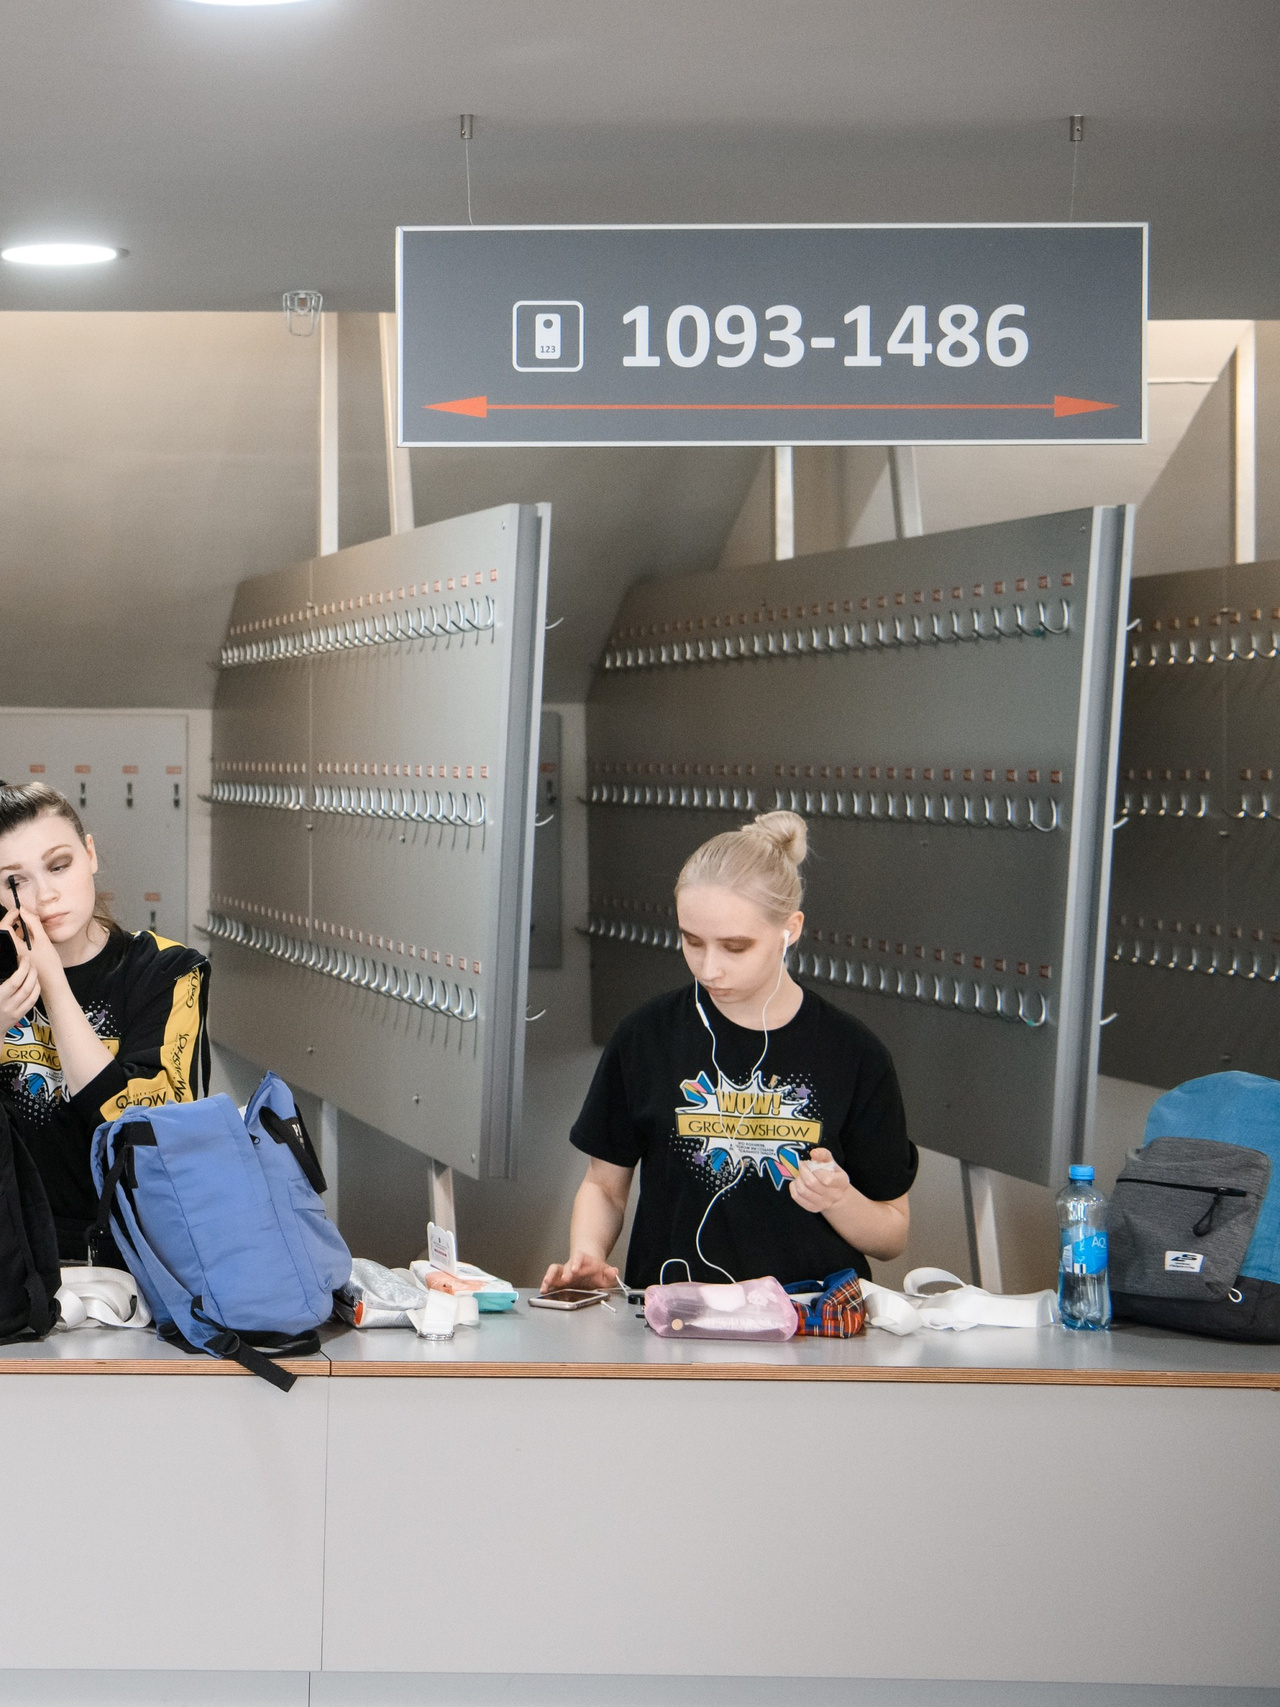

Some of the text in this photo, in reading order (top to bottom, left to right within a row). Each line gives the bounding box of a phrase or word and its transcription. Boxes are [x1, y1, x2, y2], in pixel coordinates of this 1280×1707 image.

[622, 303, 1030, 369] 1093-1486
[539, 344, 557, 354] 123
[716, 1091, 782, 1117] WOW!
[688, 1120, 811, 1138] GROMOVSHOW
[1091, 1236, 1108, 1249] AQ
